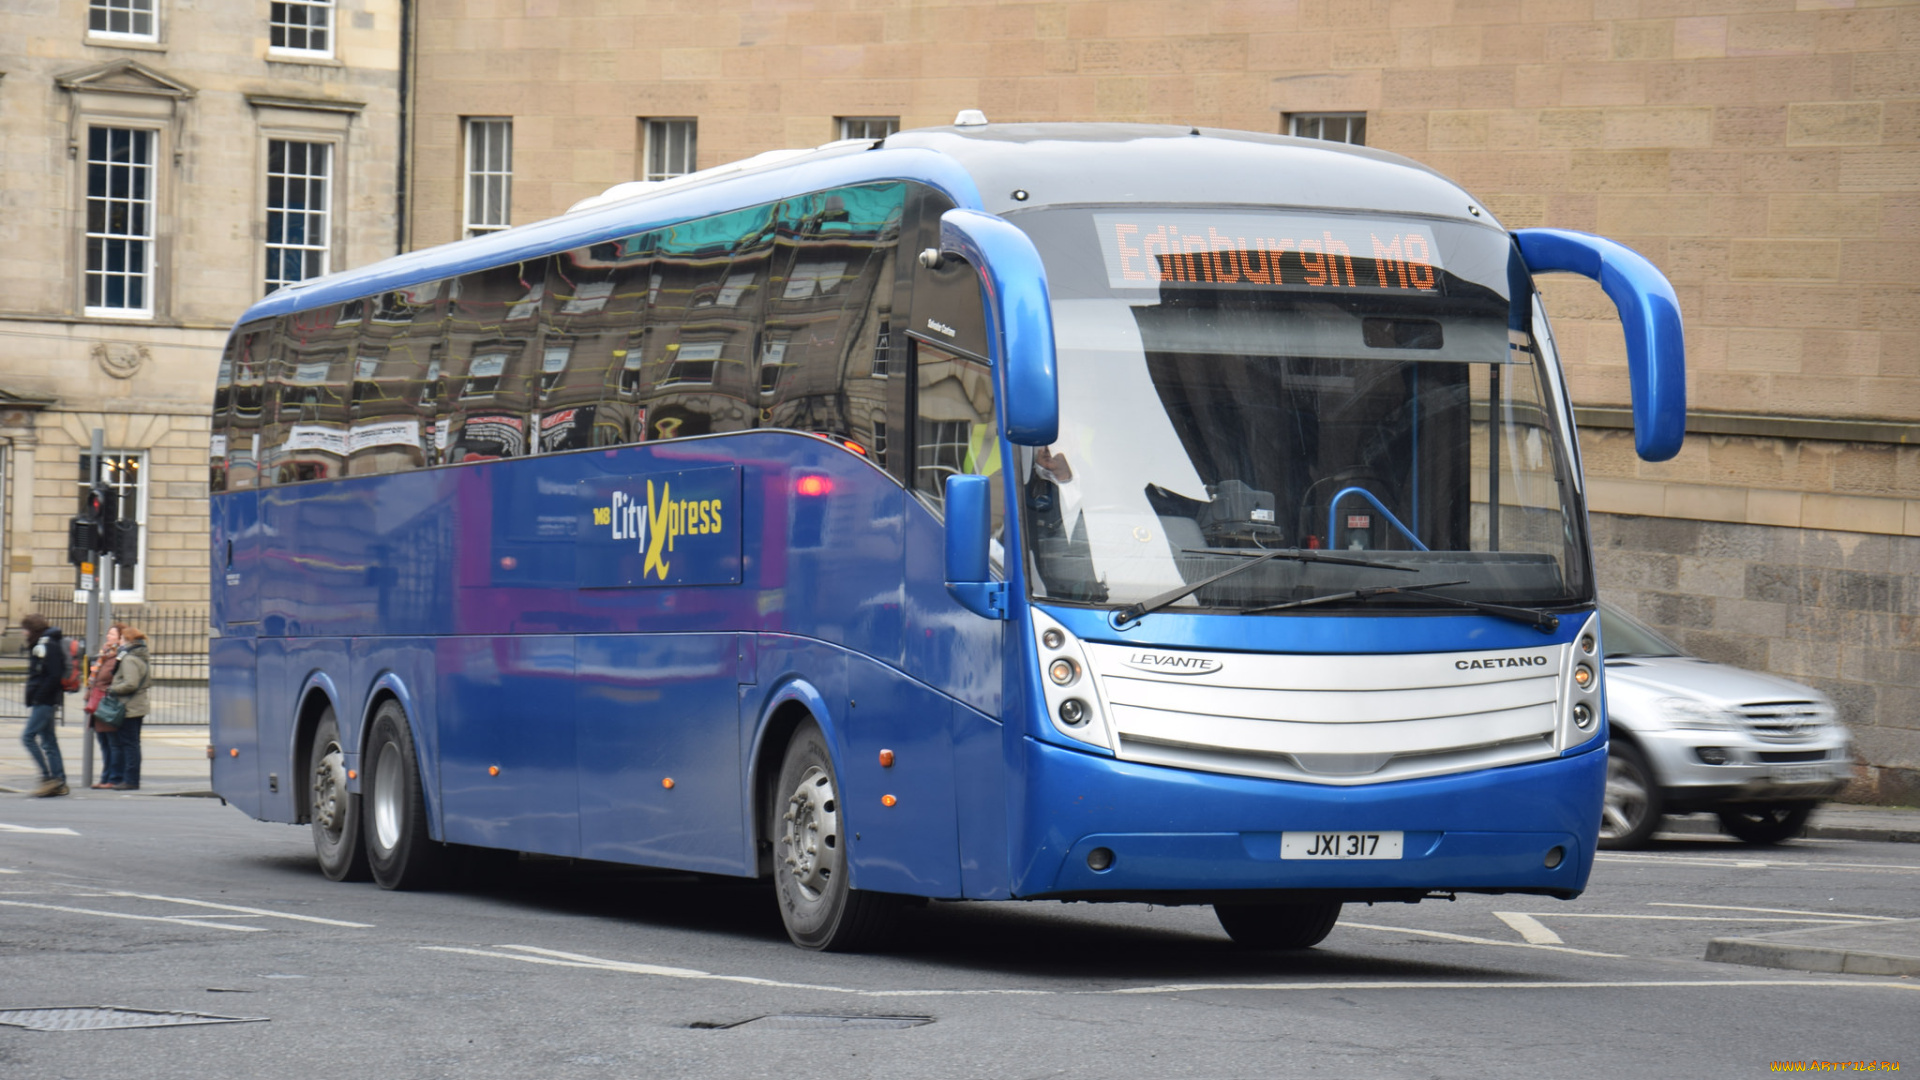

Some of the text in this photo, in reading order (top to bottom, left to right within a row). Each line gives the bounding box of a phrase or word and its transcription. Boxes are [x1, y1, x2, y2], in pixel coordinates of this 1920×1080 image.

[1115, 223, 1436, 290] Edinburgh M8
[1130, 653, 1213, 670] LEVANTE
[1455, 655, 1548, 671] CAETANO
[1306, 834, 1380, 856] JXI 317
